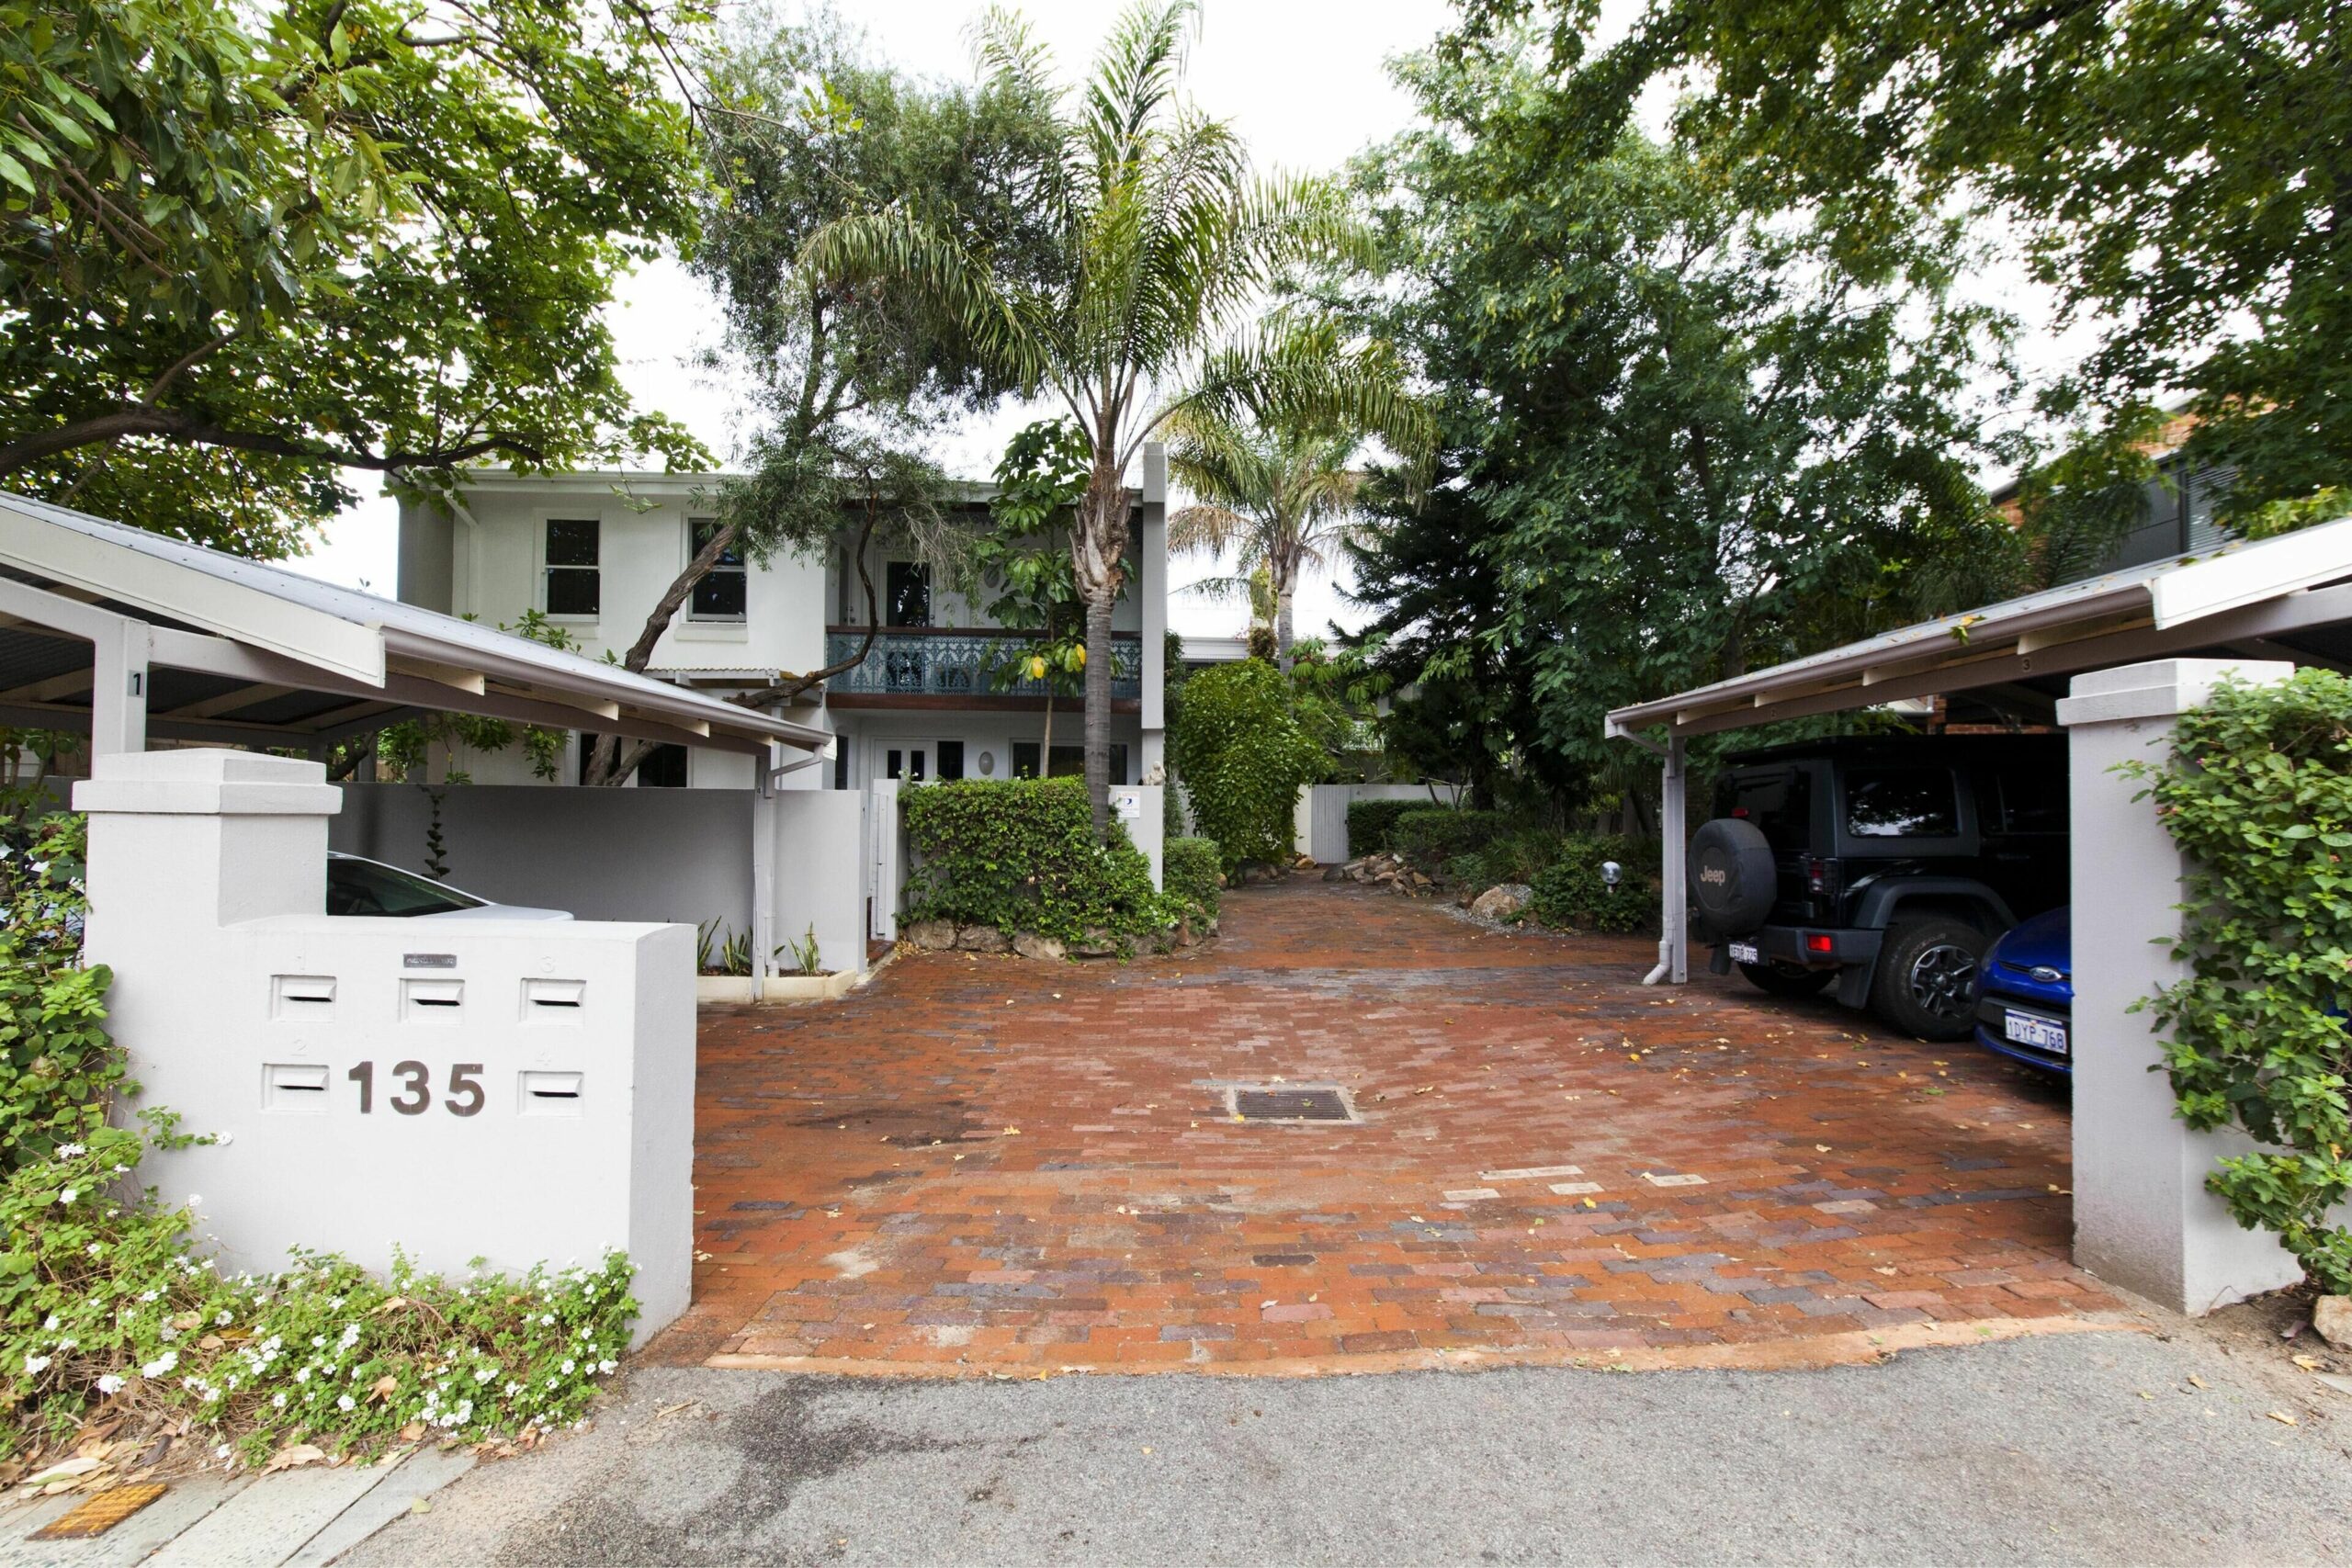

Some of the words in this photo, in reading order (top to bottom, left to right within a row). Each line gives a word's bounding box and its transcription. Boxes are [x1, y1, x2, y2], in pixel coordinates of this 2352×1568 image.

[2023, 659, 2030, 671] 3
[133, 672, 141, 695] 1
[1700, 865, 1725, 886] Jeep
[348, 1060, 485, 1117] 135
